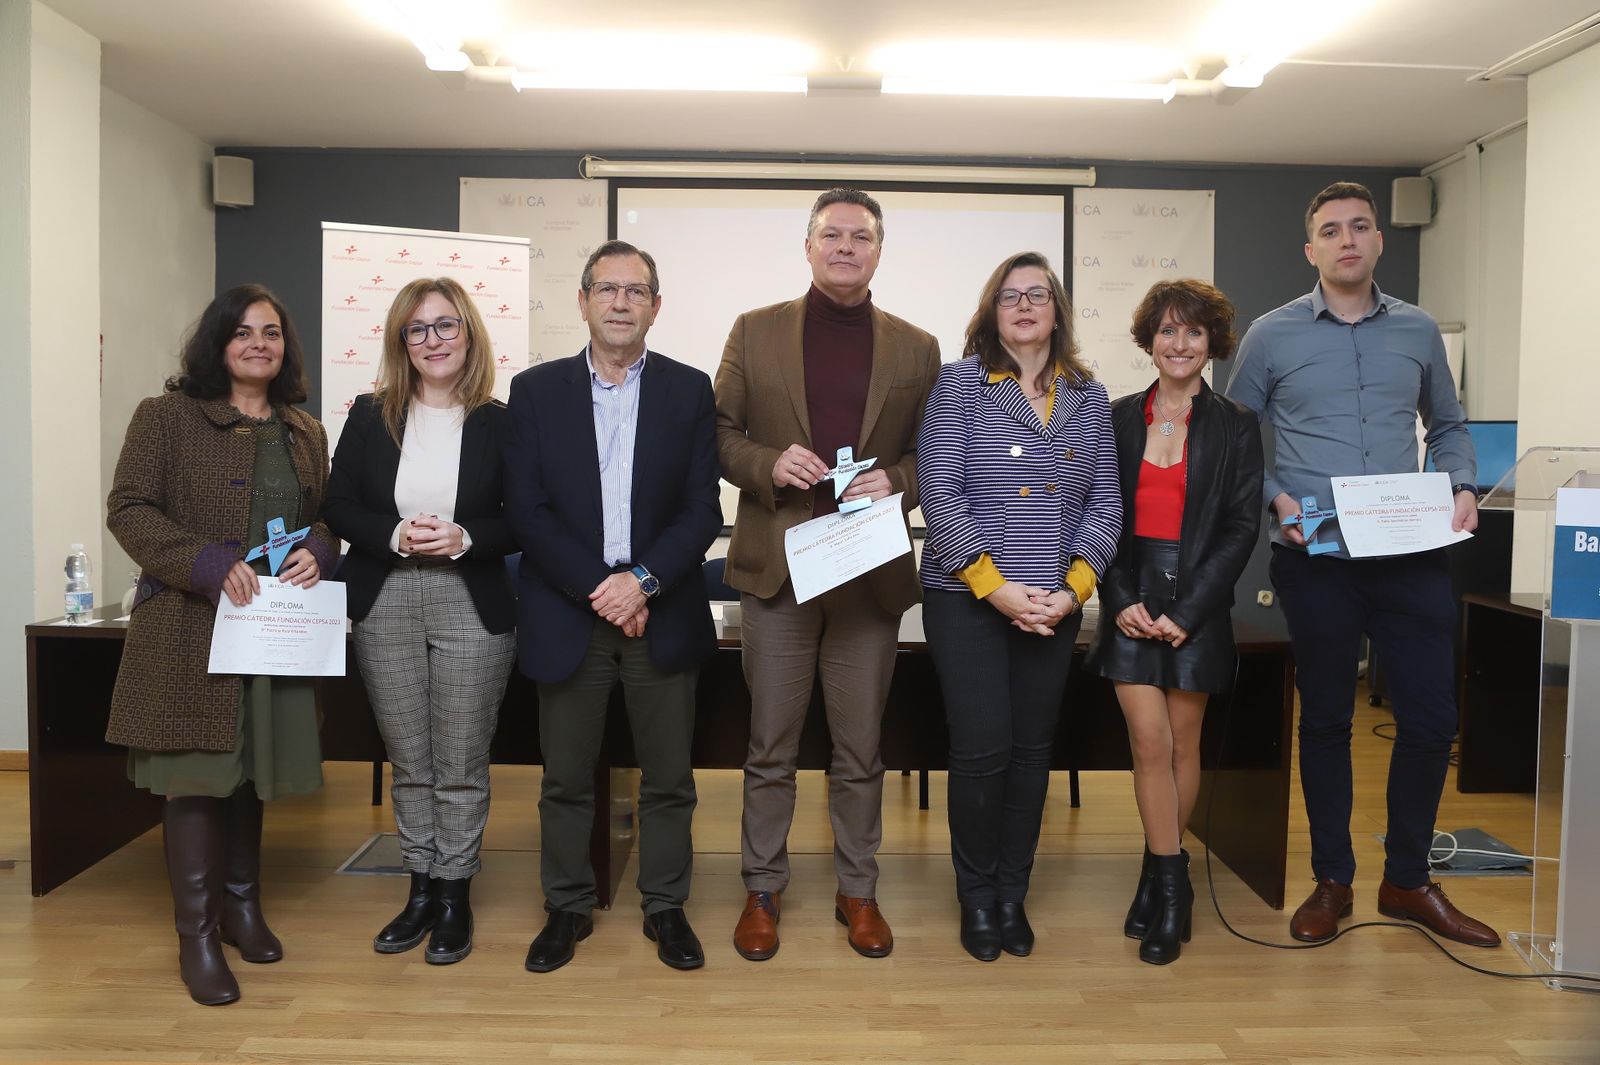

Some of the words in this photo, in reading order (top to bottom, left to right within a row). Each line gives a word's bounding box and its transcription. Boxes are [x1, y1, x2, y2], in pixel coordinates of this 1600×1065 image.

[1380, 494, 1411, 502] DIPLOMA
[1574, 531, 1600, 553] Ba
[270, 601, 304, 610] DIPLOMA
[277, 616, 311, 624] FUNDACIÓN
[312, 617, 329, 625] CEPSA
